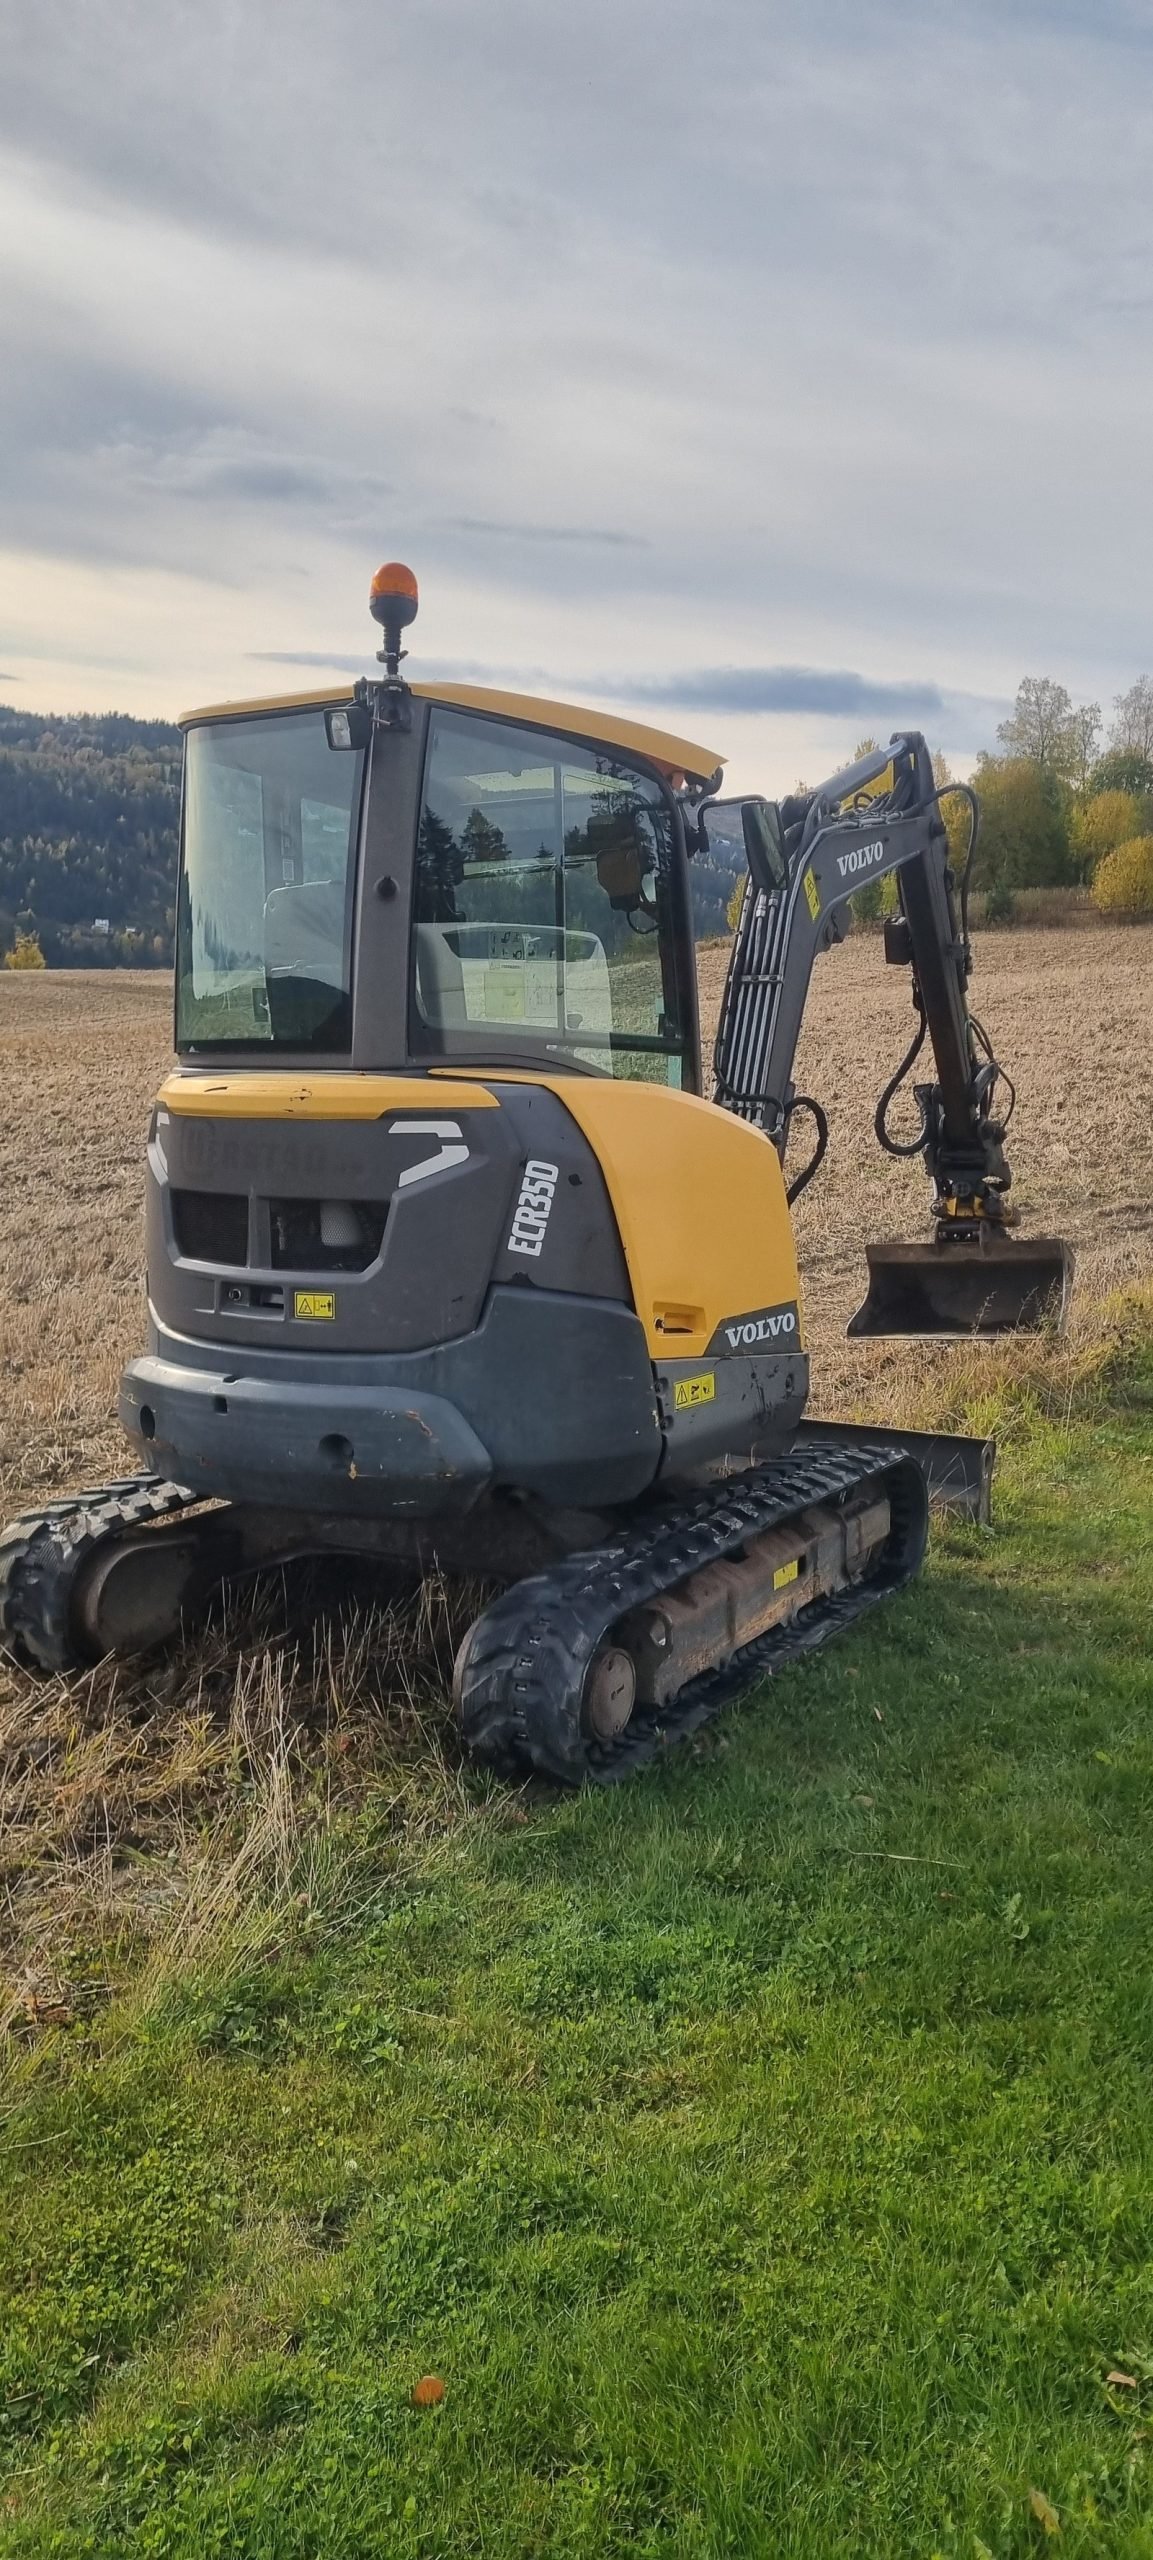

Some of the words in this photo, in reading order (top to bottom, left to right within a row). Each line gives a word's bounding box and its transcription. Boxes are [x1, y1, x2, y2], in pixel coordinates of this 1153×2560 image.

[837, 841, 883, 877] VOLVO
[507, 1160, 559, 1257] ECR35D
[725, 1312, 796, 1349] VOLVO
